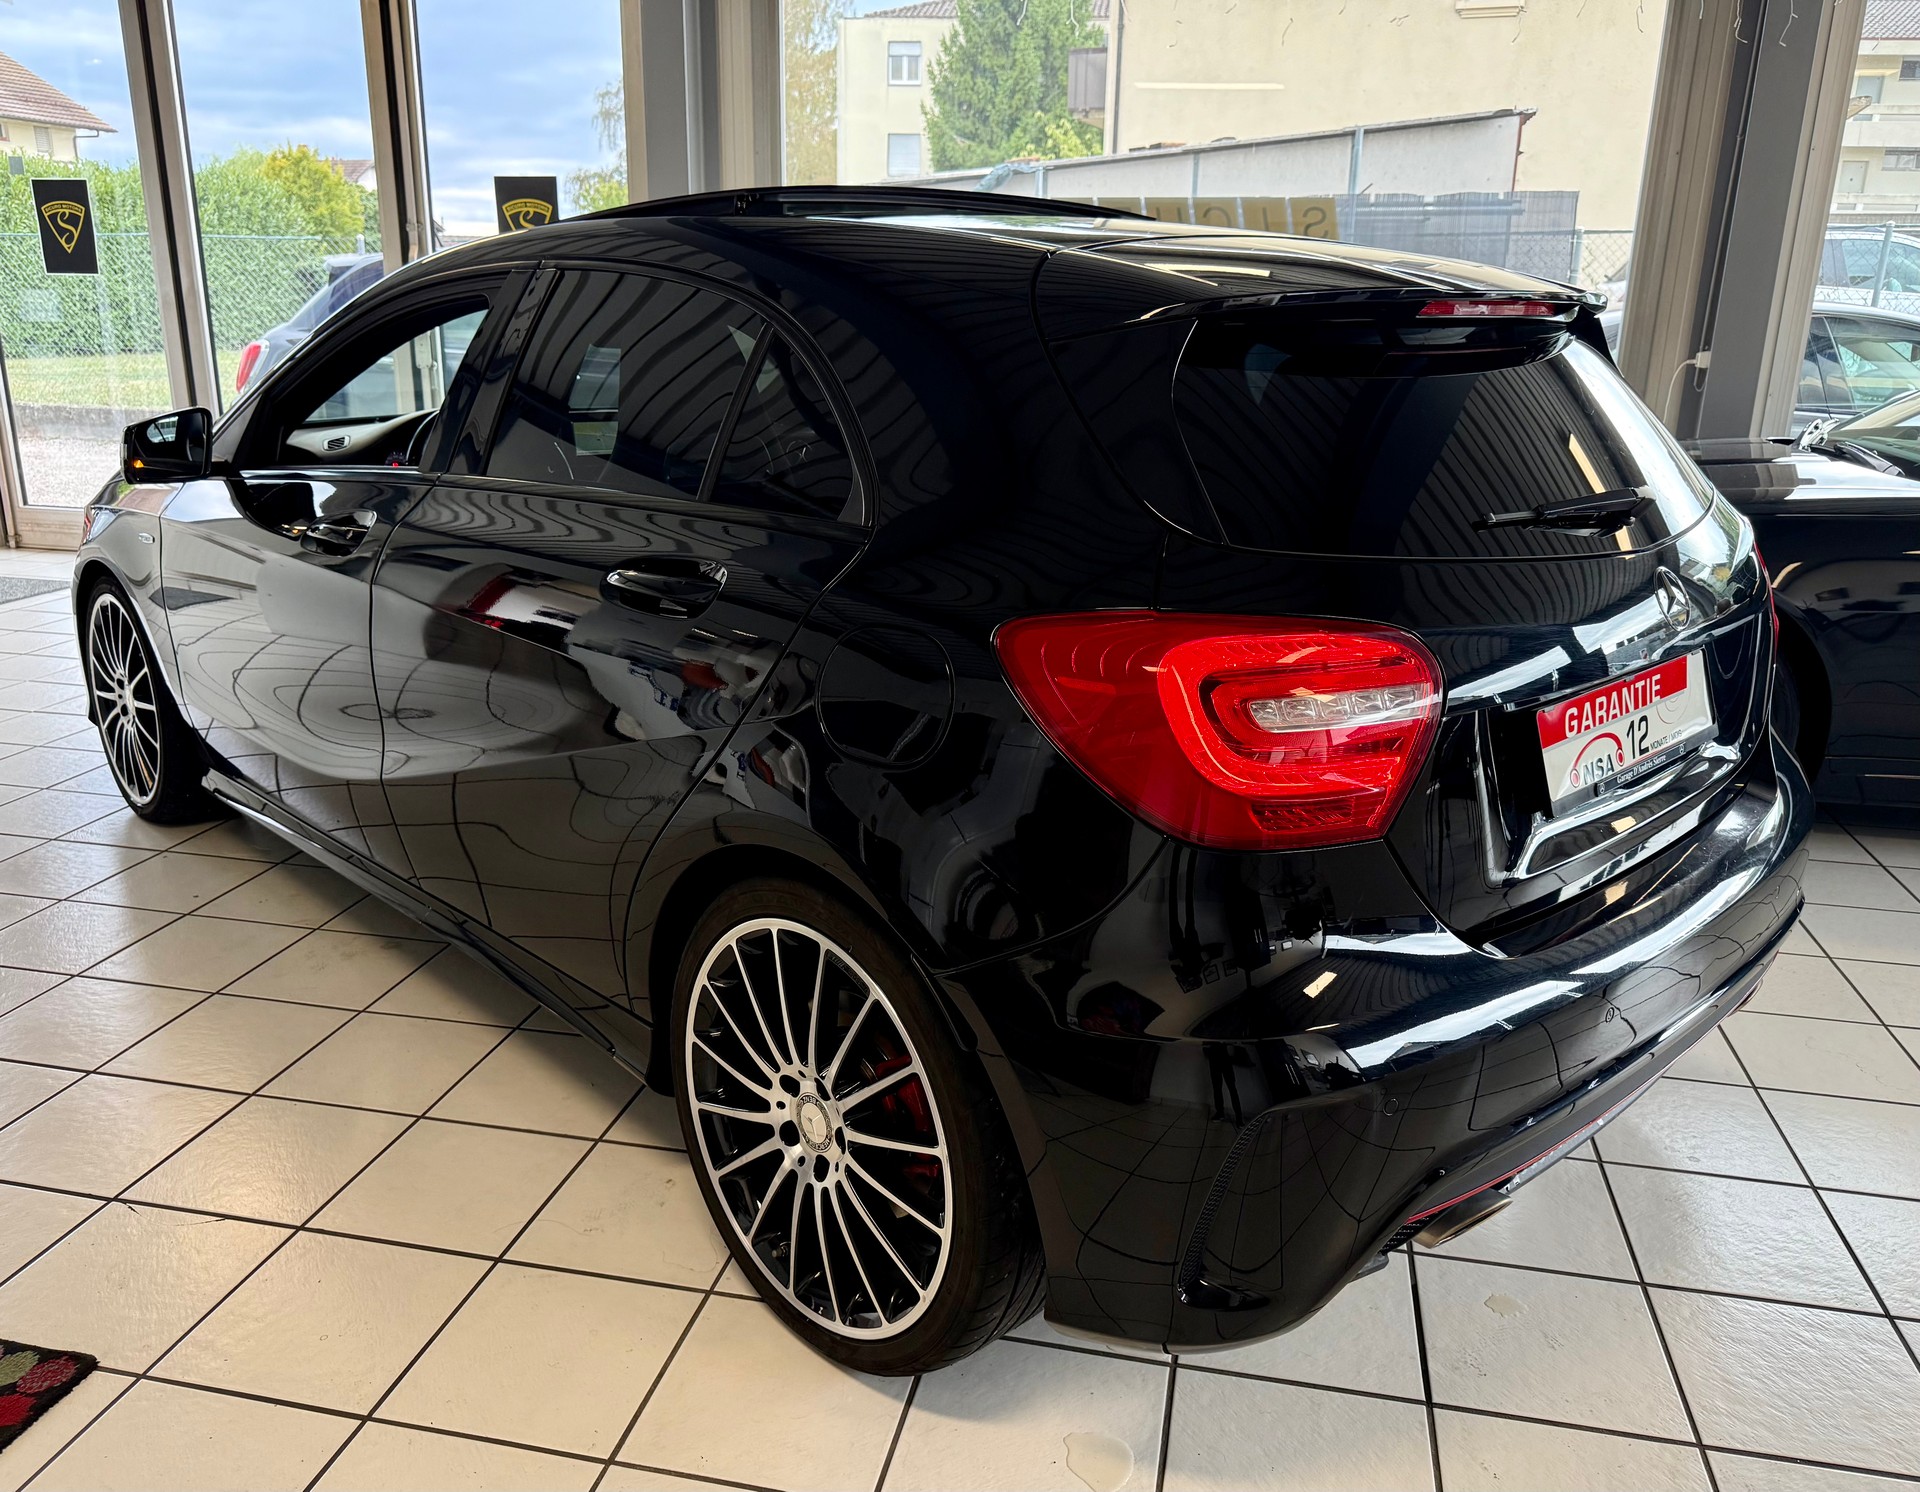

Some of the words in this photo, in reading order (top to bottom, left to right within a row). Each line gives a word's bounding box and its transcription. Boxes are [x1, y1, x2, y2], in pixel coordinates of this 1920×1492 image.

[1565, 673, 1661, 738] GARANTIE
[1626, 714, 1649, 760] 12
[1583, 753, 1615, 785] NSA
[1616, 770, 1633, 784] Garage
